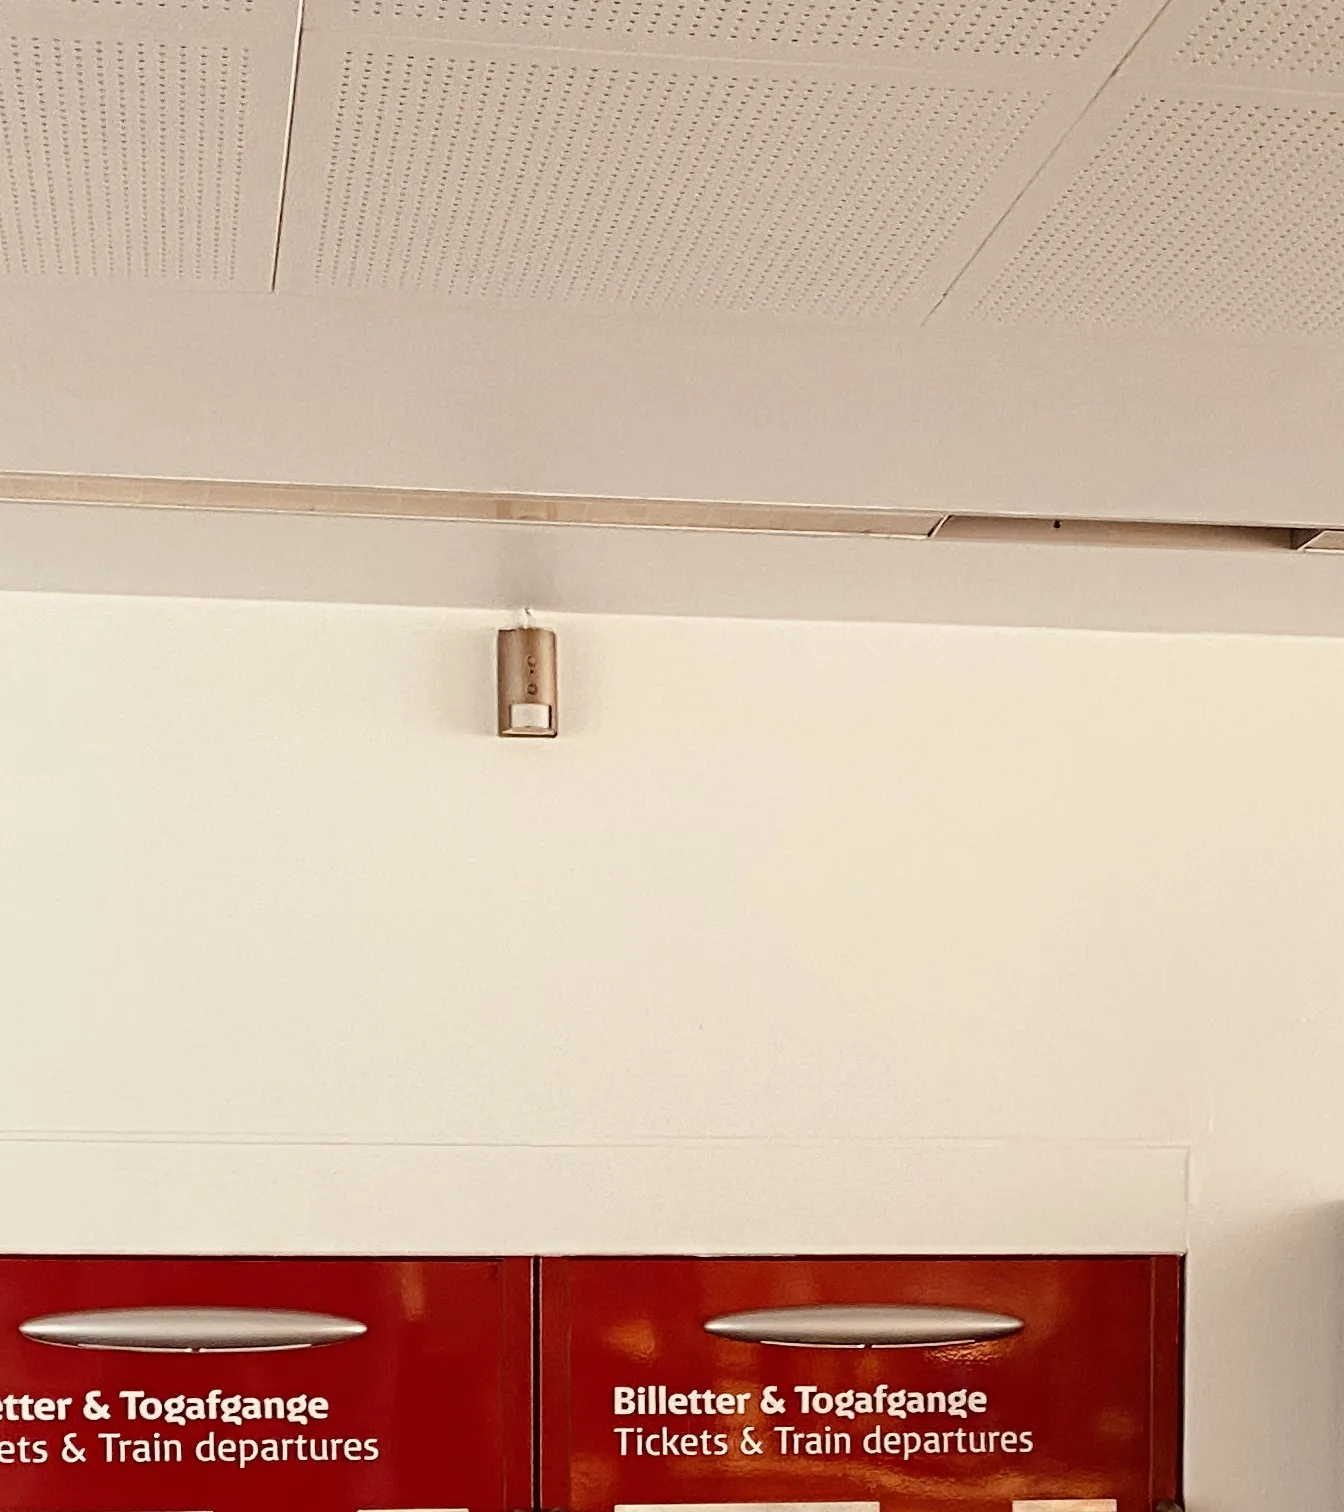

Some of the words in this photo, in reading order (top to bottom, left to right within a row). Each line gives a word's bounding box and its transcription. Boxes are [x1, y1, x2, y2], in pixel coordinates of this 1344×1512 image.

[83, 1390, 111, 1420] &
[119, 1390, 328, 1425] Togafgange
[615, 1386, 751, 1414] Billetter
[761, 1386, 785, 1414] &
[794, 1385, 987, 1419] Togafgange
[62, 1433, 86, 1462] &
[98, 1433, 181, 1462] Train
[196, 1432, 378, 1468] departures
[614, 1427, 728, 1456] Tickets
[740, 1427, 763, 1455] &
[774, 1426, 850, 1454] Train
[863, 1425, 1033, 1460] departures
